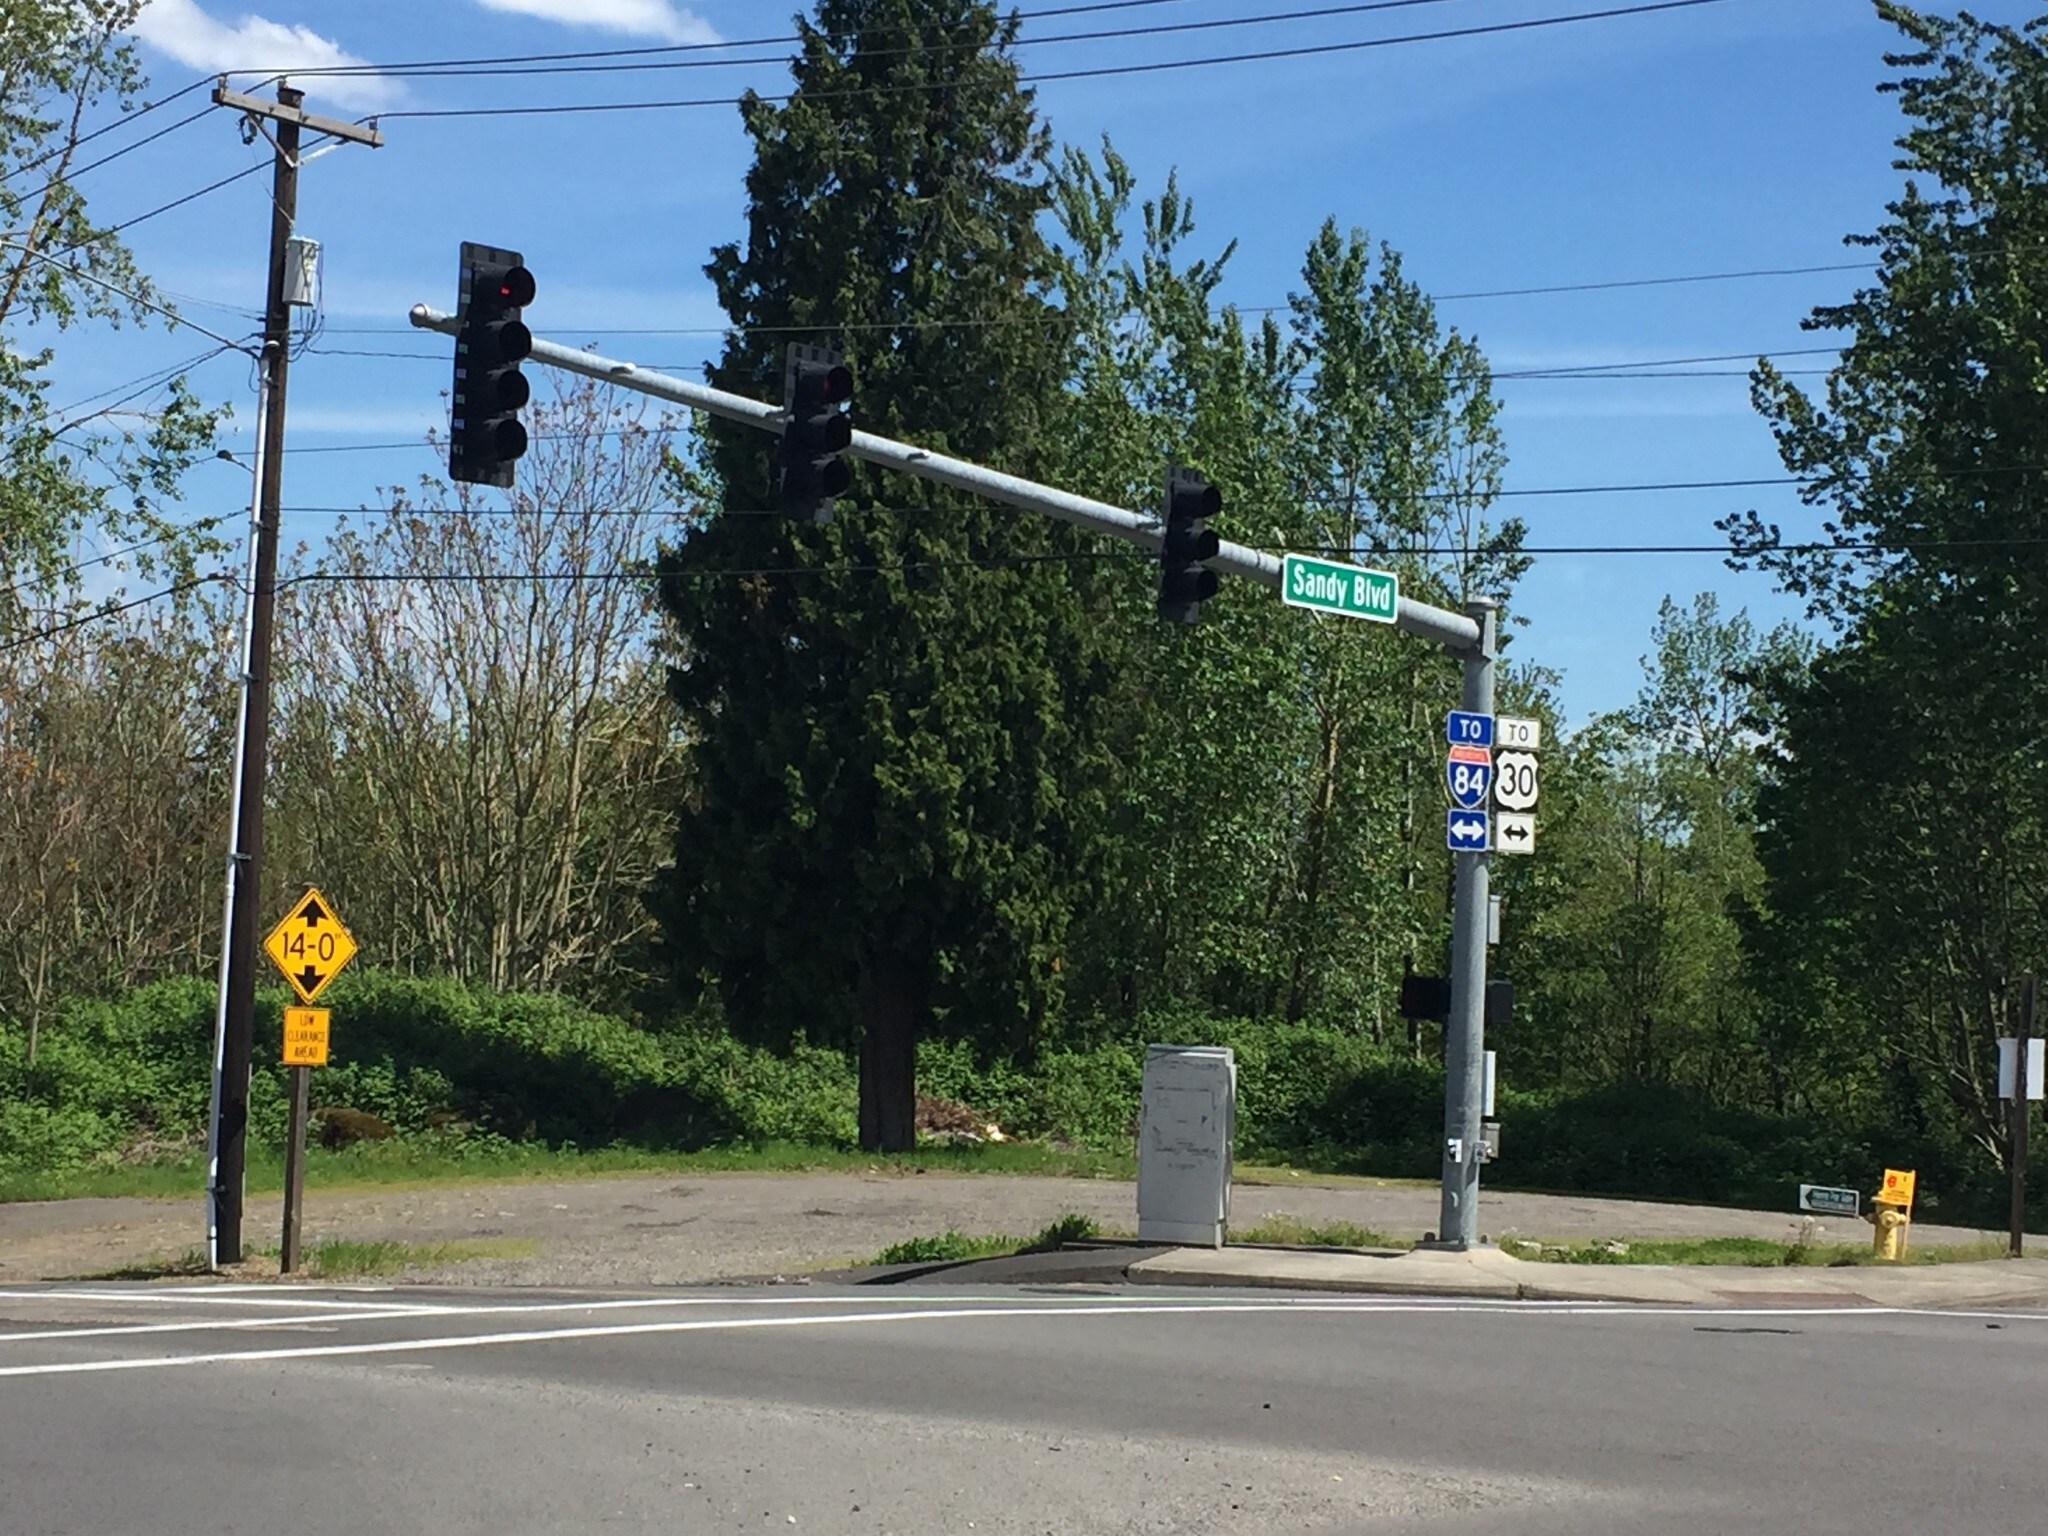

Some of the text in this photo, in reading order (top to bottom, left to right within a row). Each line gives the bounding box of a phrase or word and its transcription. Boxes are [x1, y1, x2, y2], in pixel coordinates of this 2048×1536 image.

[1293, 563, 1391, 611] Sandy Blvd
[1459, 719, 1482, 739] TO
[1508, 723, 1529, 742] TO
[1454, 765, 1484, 797] 84
[1501, 763, 1534, 797] 30
